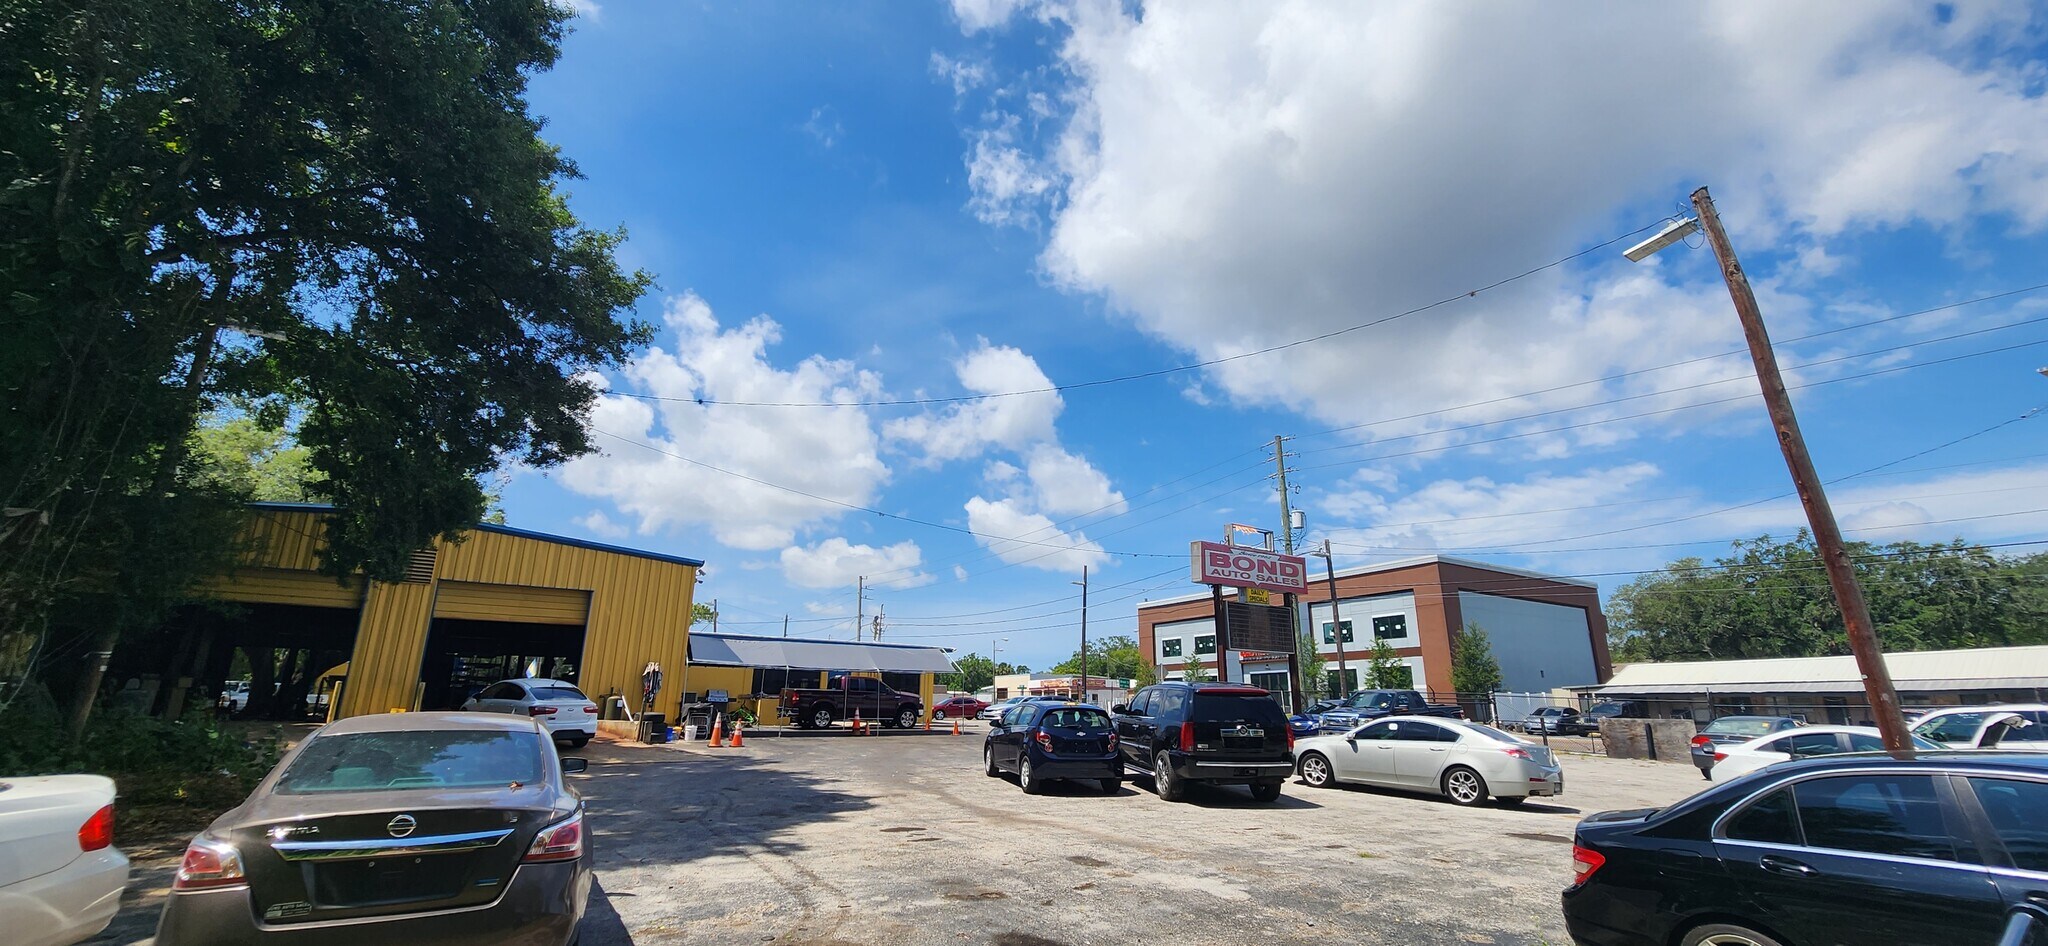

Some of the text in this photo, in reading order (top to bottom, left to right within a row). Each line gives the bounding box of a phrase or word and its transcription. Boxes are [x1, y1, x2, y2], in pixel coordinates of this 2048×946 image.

[1209, 552, 1300, 577] BOND
[1211, 568, 1300, 586] AUTO SALES
